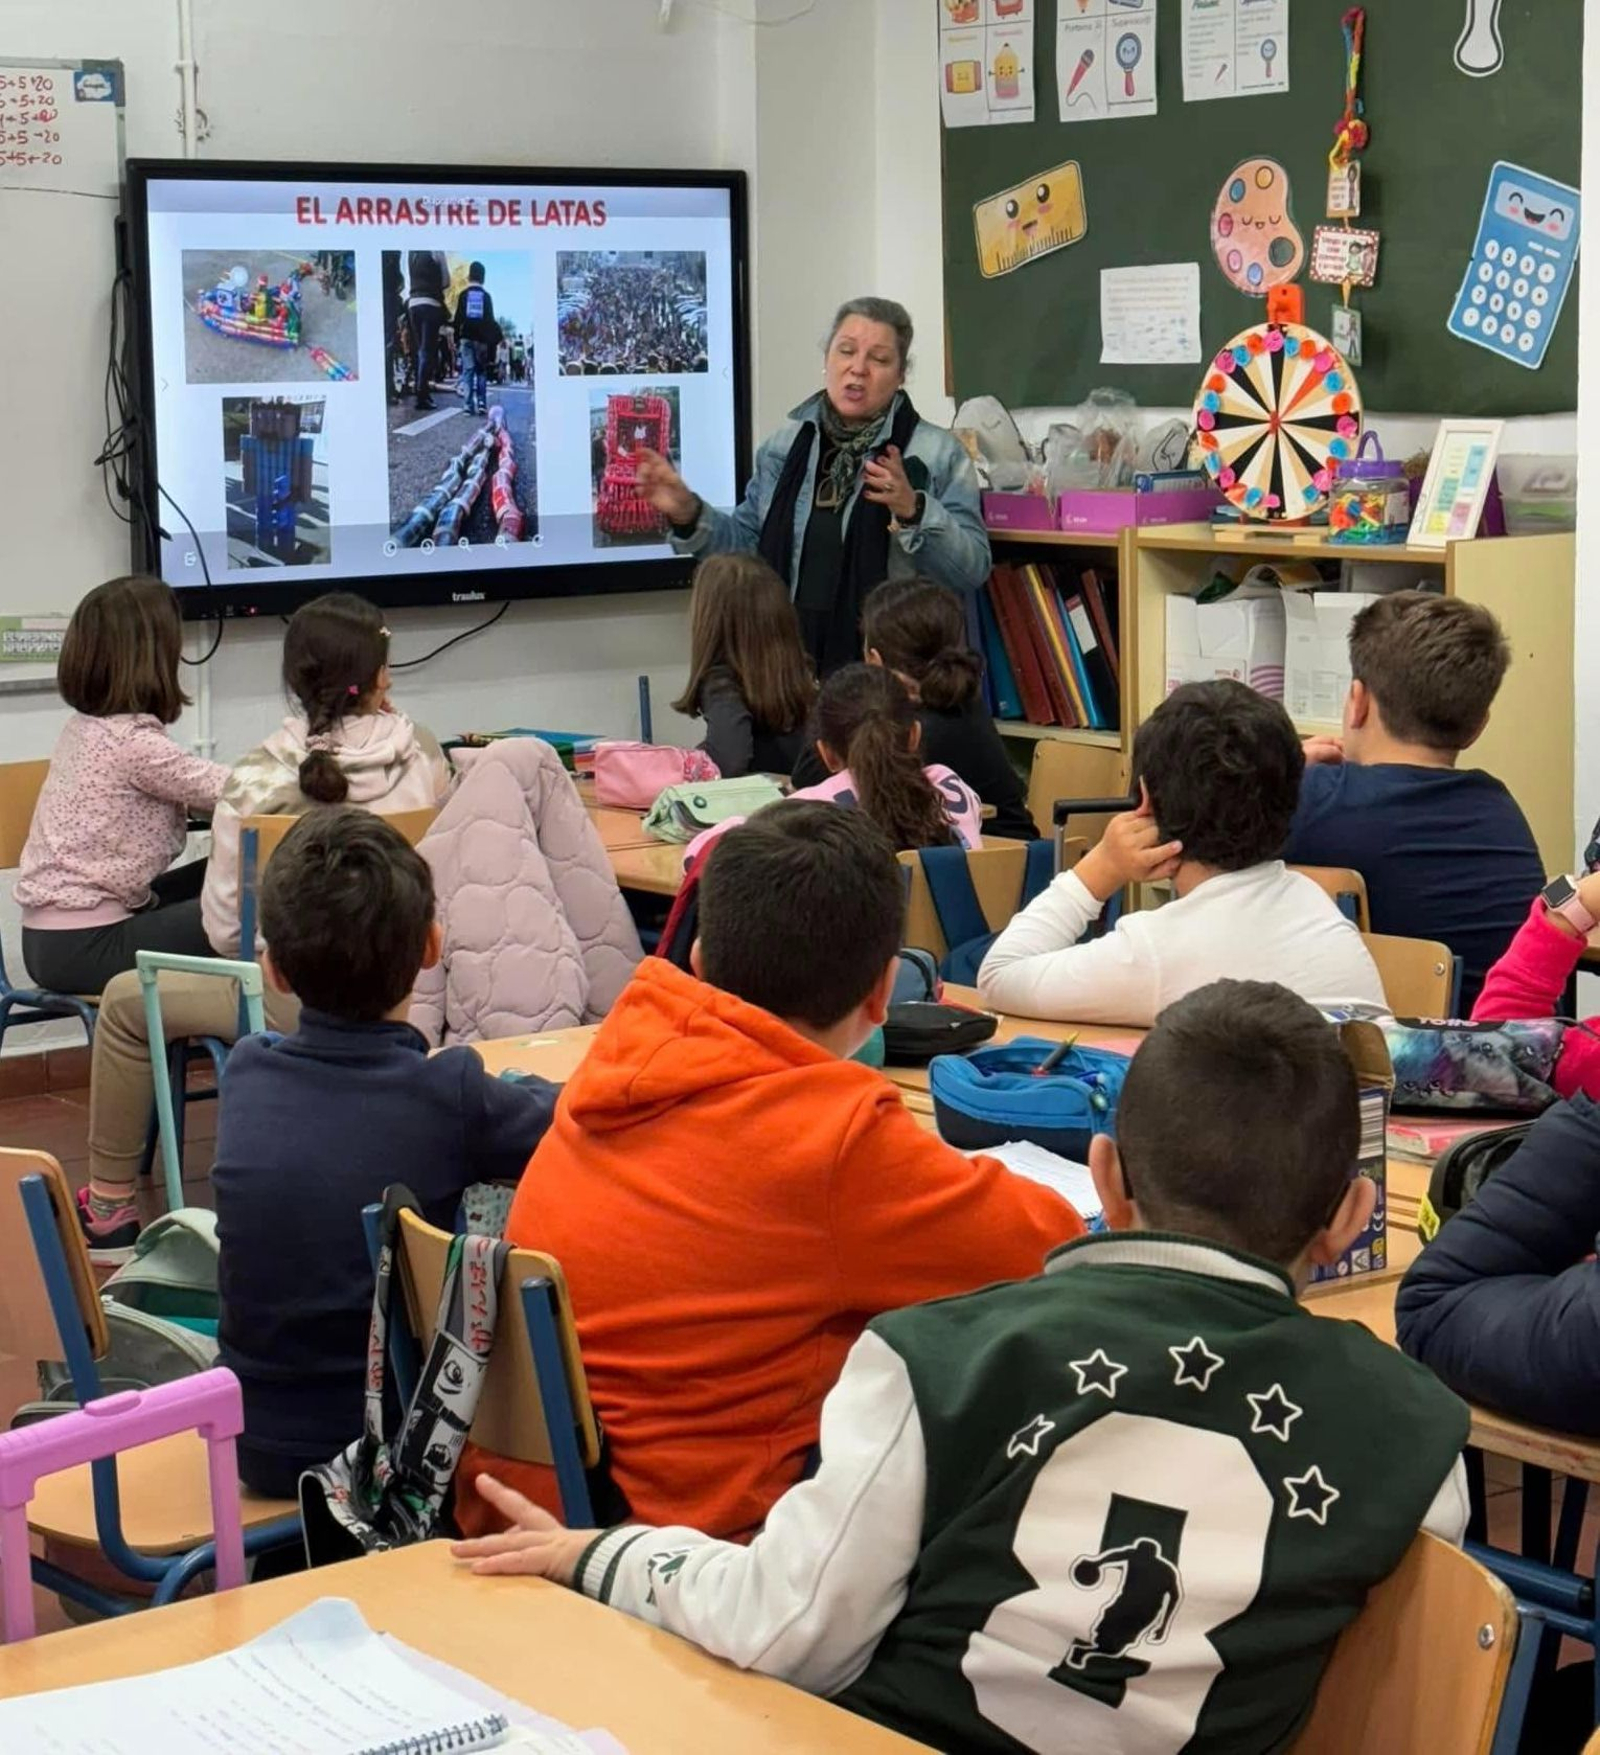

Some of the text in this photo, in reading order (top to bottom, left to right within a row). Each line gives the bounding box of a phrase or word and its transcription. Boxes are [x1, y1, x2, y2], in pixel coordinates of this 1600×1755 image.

[296, 196, 327, 224] EL
[335, 197, 480, 226] ARRASTRE
[488, 199, 522, 226] DE
[531, 200, 607, 227] LATAS
